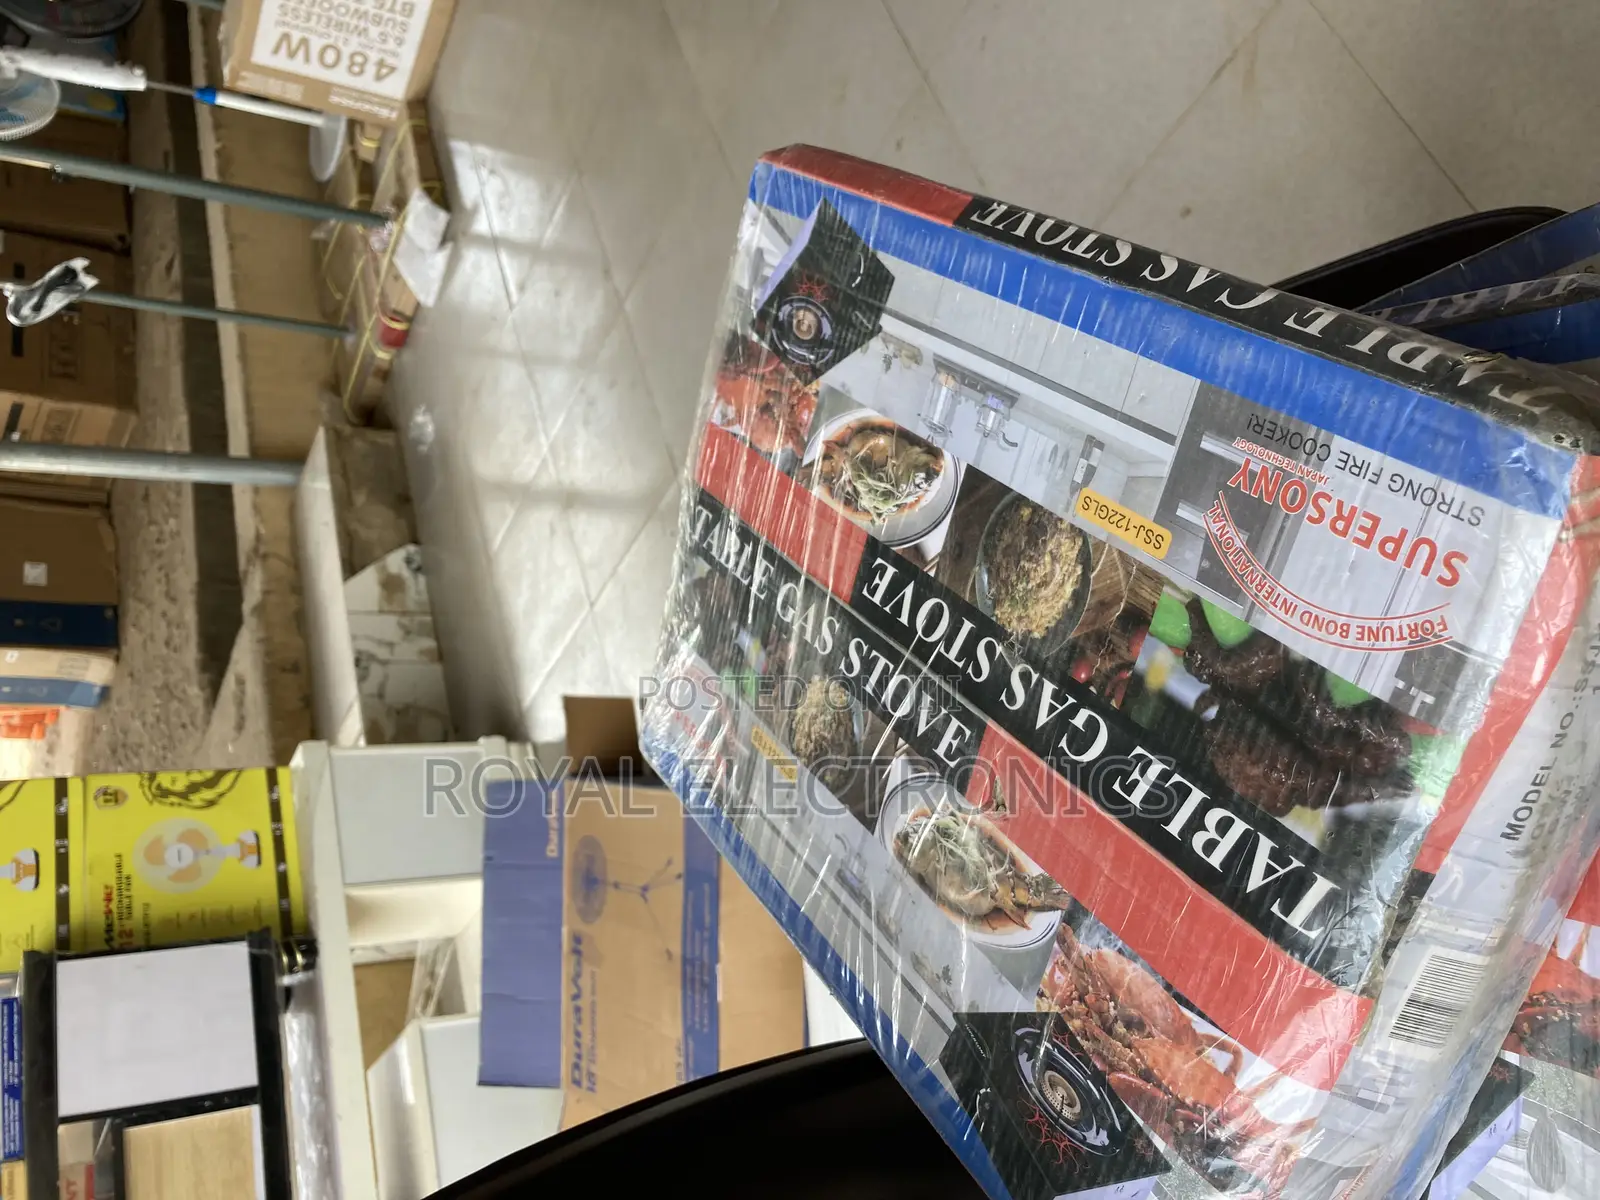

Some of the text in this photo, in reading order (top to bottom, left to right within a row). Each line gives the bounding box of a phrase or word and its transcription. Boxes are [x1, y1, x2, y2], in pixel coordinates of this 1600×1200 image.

[271, 32, 397, 82] 480W
[277, 3, 370, 38] WIRELESS
[970, 201, 1133, 267] STOVE
[1232, 436, 1330, 486] JAPAN TECHNOLOGY
[1247, 412, 1486, 528] STRONG FIRE COOKER!
[1081, 495, 1165, 550] SSJ-122GLS
[1208, 500, 1450, 643] FORTUNE BOND INTERNATIONAL
[1227, 456, 1470, 588] SUPERSONY
[691, 505, 774, 600] TABLE
[776, 581, 840, 655] GAS
[839, 637, 972, 768] STOVE
[861, 557, 1341, 940] TABLE GAS STOVE
[1500, 756, 1558, 841] MODEL
[570, 930, 584, 1089] DuraVolt
